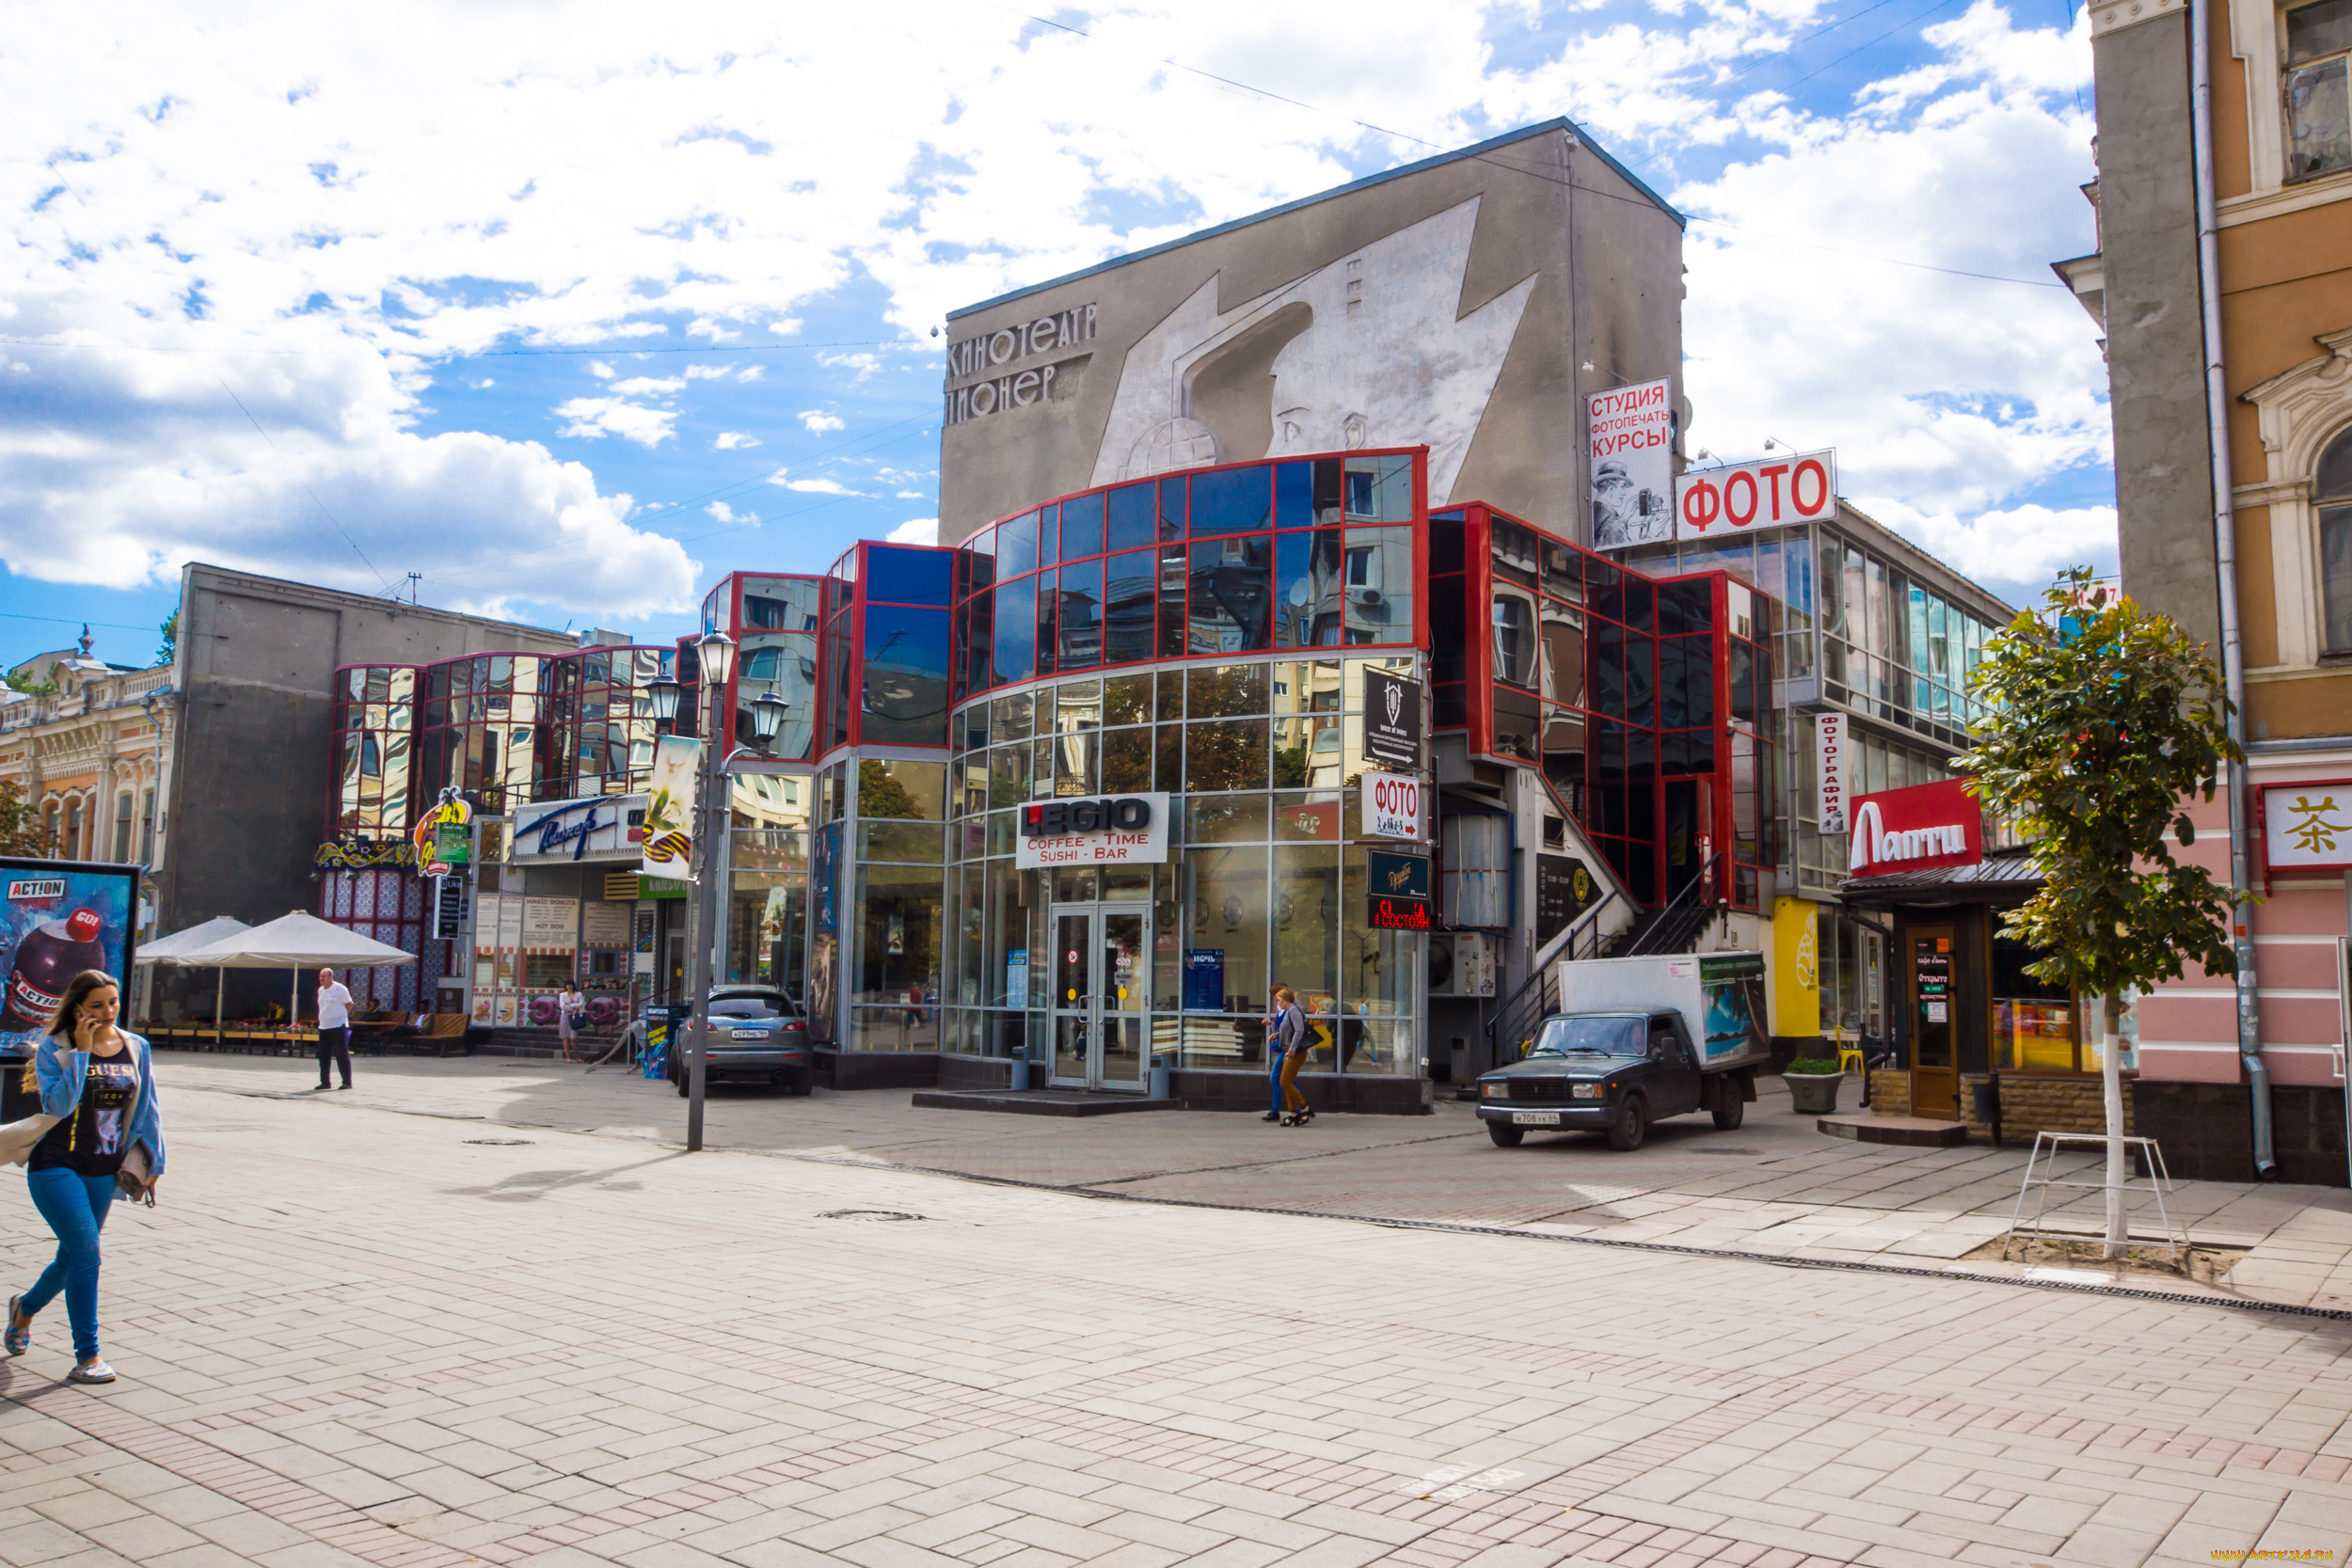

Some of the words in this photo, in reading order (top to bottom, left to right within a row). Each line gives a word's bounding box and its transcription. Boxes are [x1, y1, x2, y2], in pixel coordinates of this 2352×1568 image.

[1591, 385, 1664, 417] СТУДИЯ
[1591, 409, 1670, 436] ФОТОПЕЧАТЬ
[1592, 426, 1666, 458] КУРСЫ
[1682, 459, 1828, 532] ФОТО
[1820, 717, 1841, 814] ФОТОГРАФИЯ
[1375, 778, 1417, 818] ФОТО
[1021, 798, 1151, 837] LEGIO
[2283, 796, 2352, 854] 茶
[1027, 836, 1085, 850] COFFEE
[1104, 833, 1149, 846] TIME
[1851, 800, 1968, 870] Лапти
[1040, 850, 1078, 863] SUSHI
[1094, 847, 1127, 860] BAR
[76, 911, 99, 927] GO!
[1382, 913, 1430, 929] СОСТОЯН
[1193, 955, 1216, 963] НОЧЬ
[1918, 973, 1947, 985] Открыто
[87, 1065, 135, 1076] GUES
